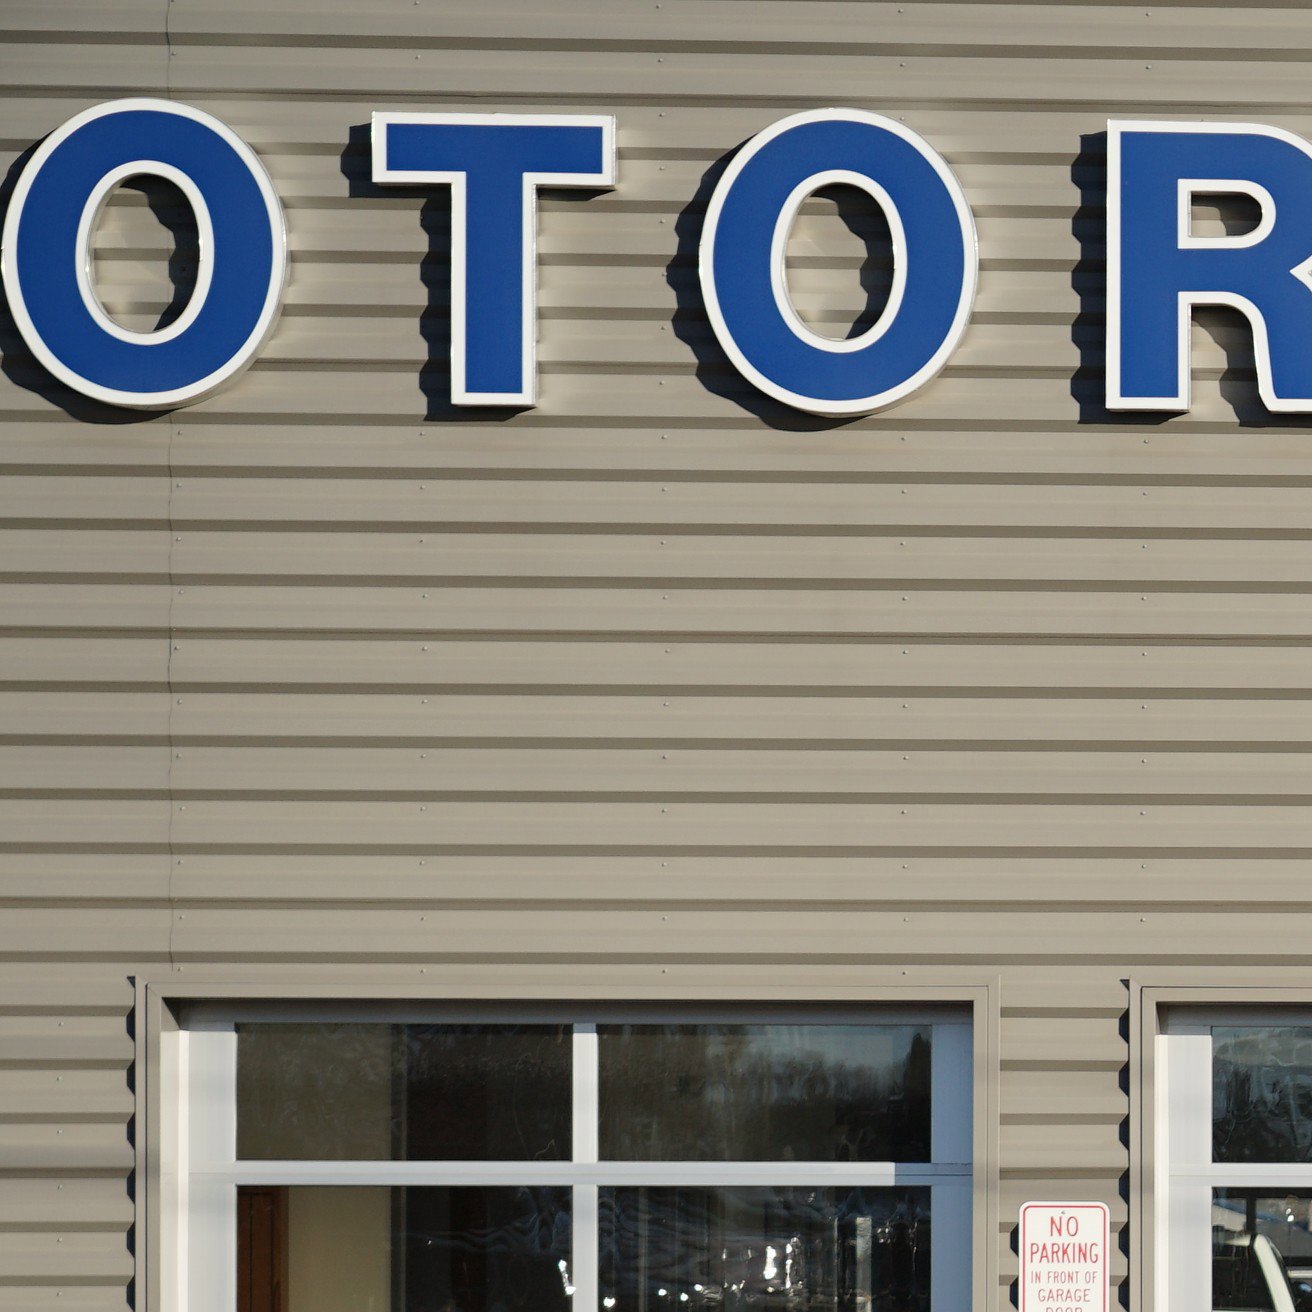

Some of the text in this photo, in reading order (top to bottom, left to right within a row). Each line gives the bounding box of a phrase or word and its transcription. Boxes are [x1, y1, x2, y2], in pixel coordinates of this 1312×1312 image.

[1050, 1216, 1079, 1237] NO
[1030, 1243, 1099, 1264] PARKING
[1031, 1271, 1098, 1284] IN FRONT OF
[1038, 1289, 1091, 1302] GARAGE
